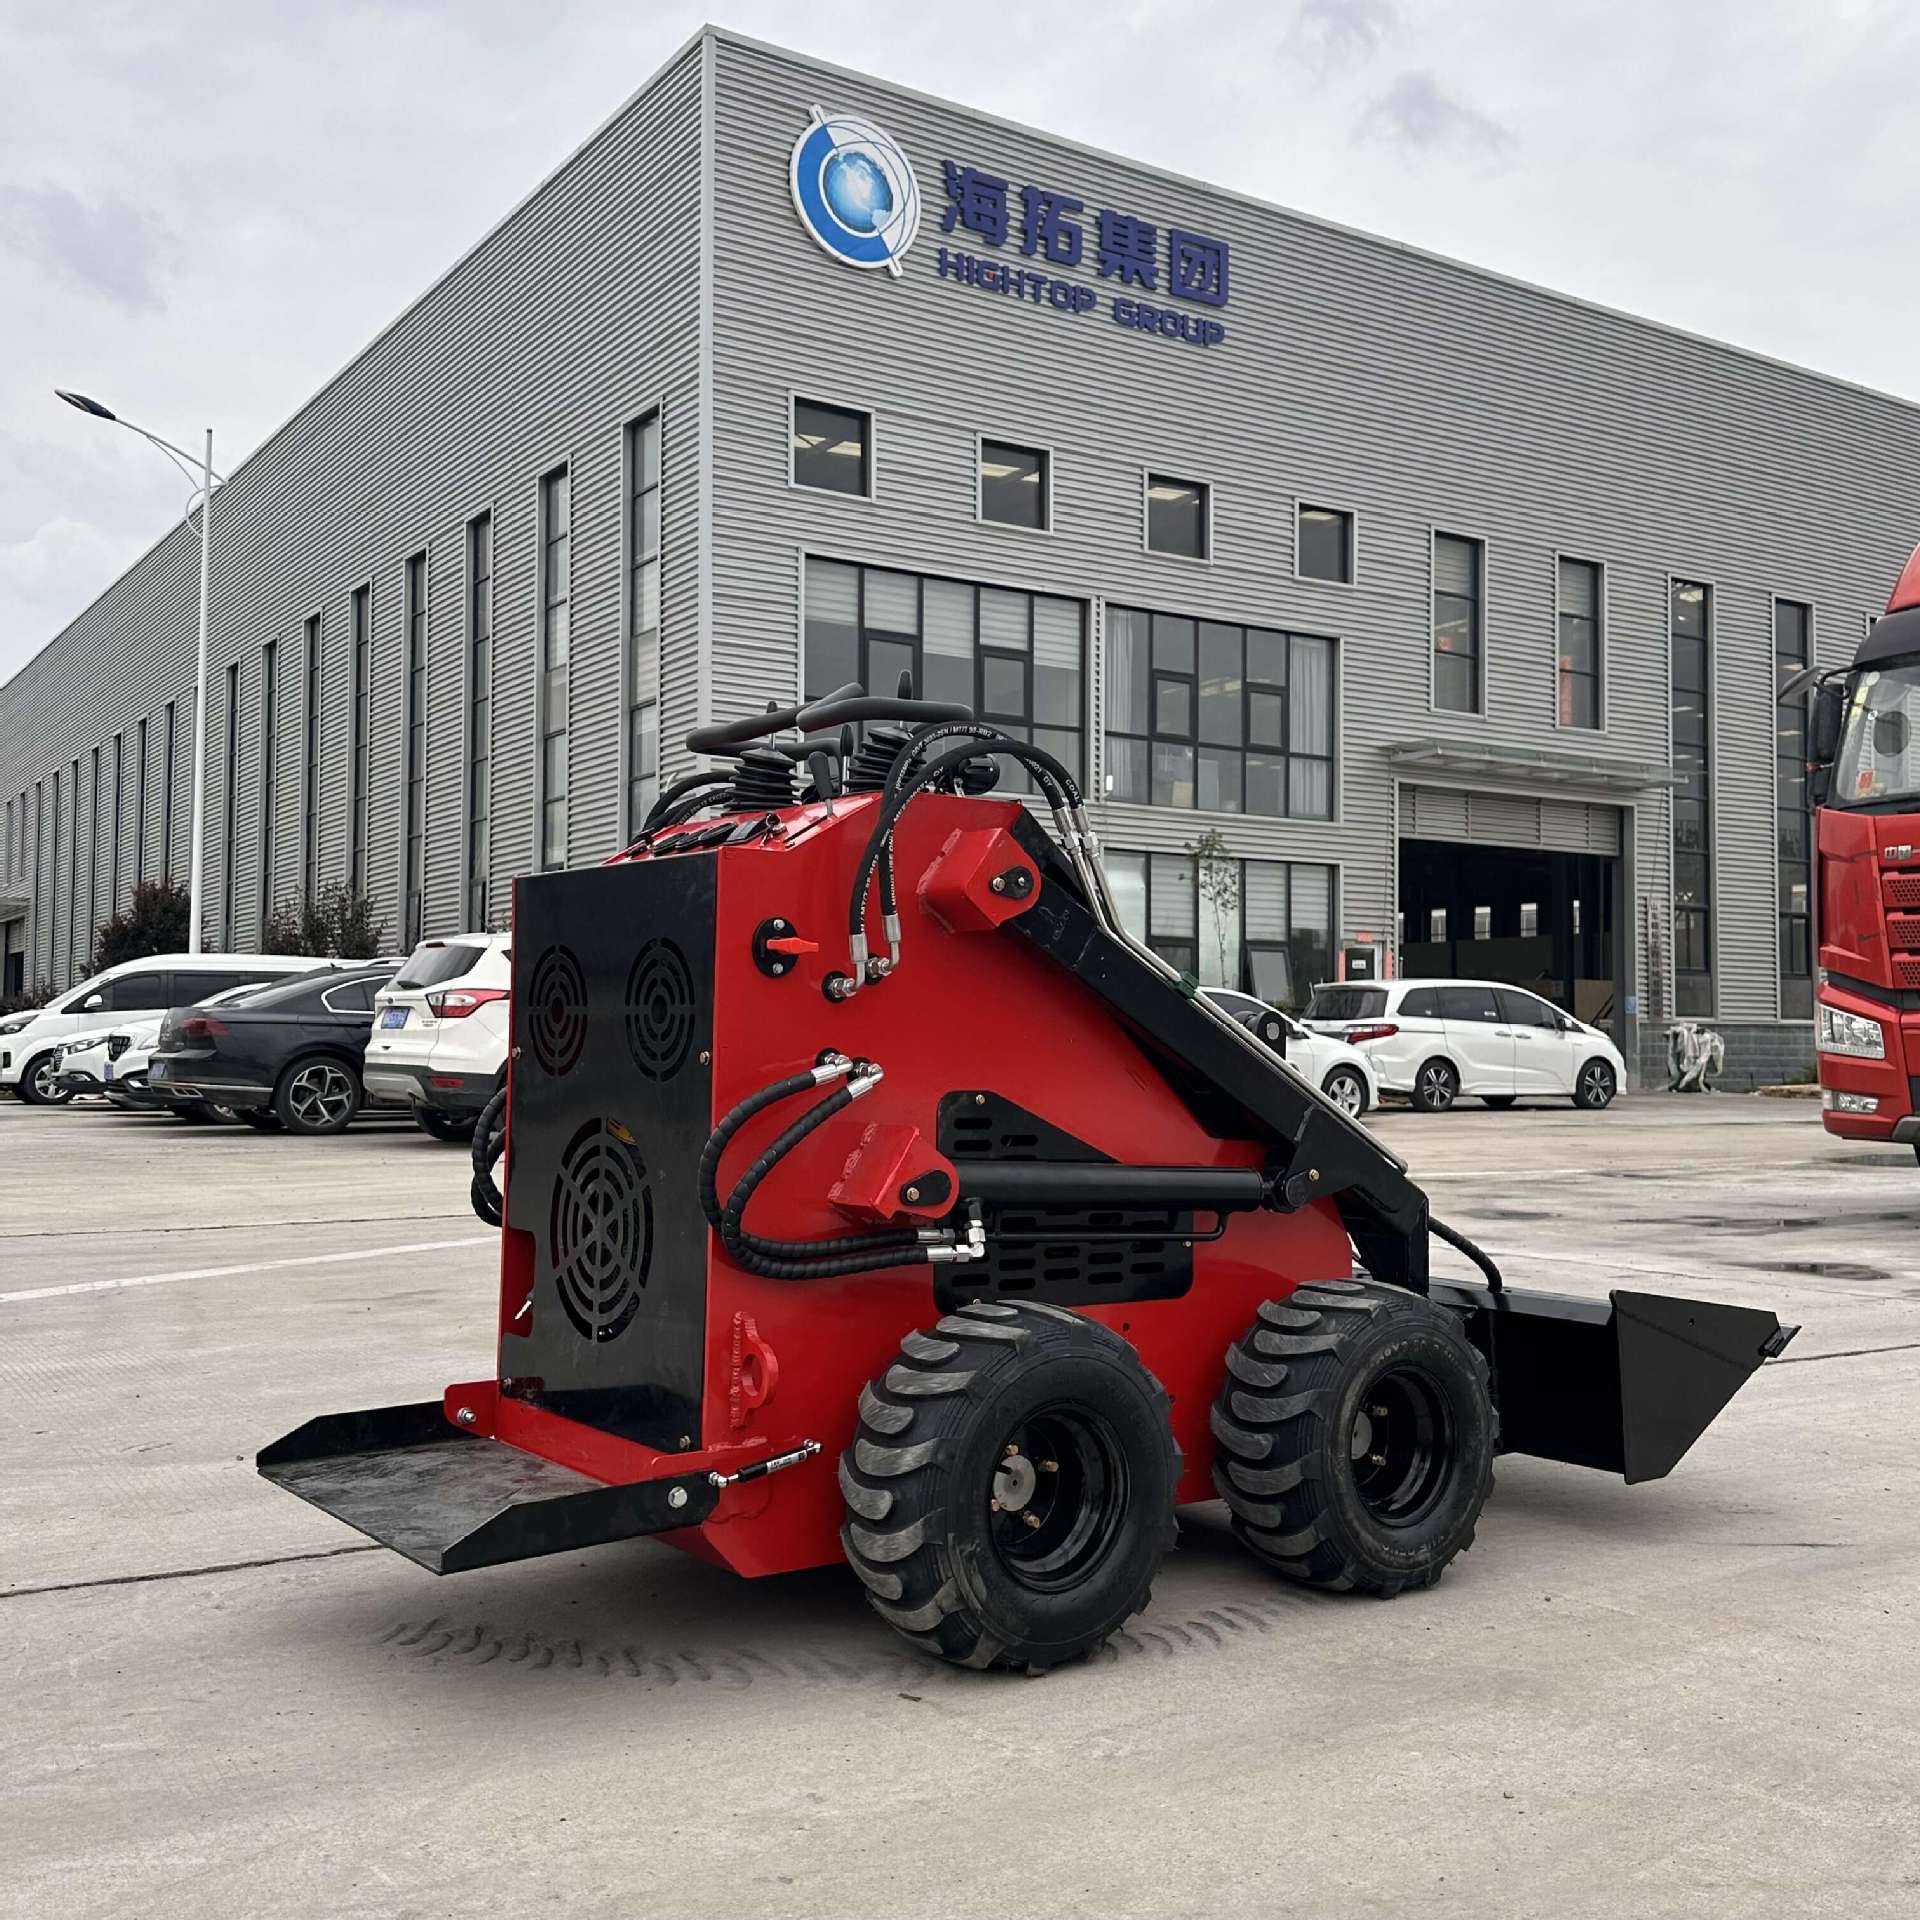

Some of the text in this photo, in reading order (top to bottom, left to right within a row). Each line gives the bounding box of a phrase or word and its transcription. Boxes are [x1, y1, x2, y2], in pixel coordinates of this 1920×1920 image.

[941, 159, 1229, 307] 海拓集团
[938, 247, 1225, 347] HIGHTOP GROUP
